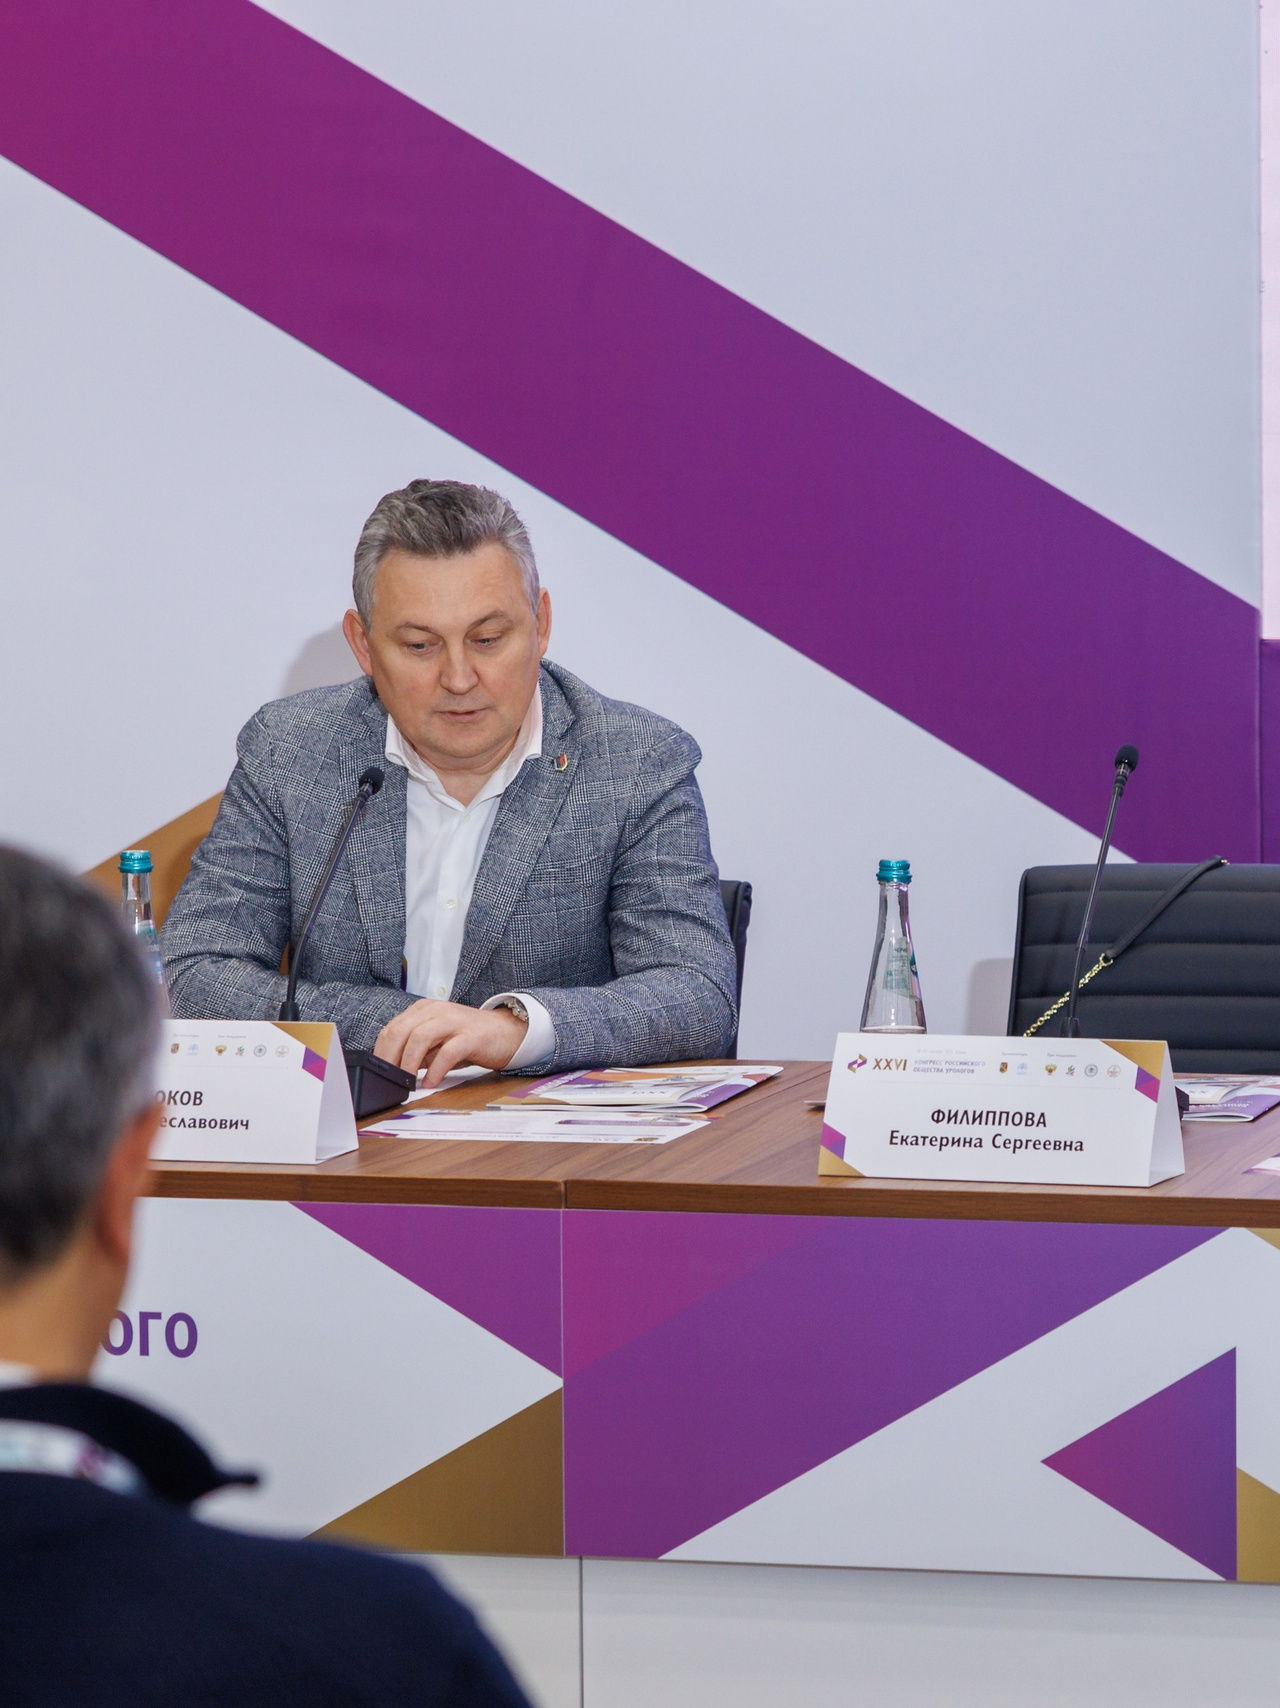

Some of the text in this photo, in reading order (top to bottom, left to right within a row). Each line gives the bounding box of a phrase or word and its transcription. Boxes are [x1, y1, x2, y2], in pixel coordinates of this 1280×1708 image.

[873, 1057, 908, 1071] XXVI
[154, 1089, 204, 1107] ОКОВ
[159, 1116, 250, 1130] еславович
[931, 1108, 1047, 1128] ФИЛИППОВА
[889, 1130, 1084, 1154] Екатерина Сергеевна
[101, 1309, 198, 1358] ОГО
